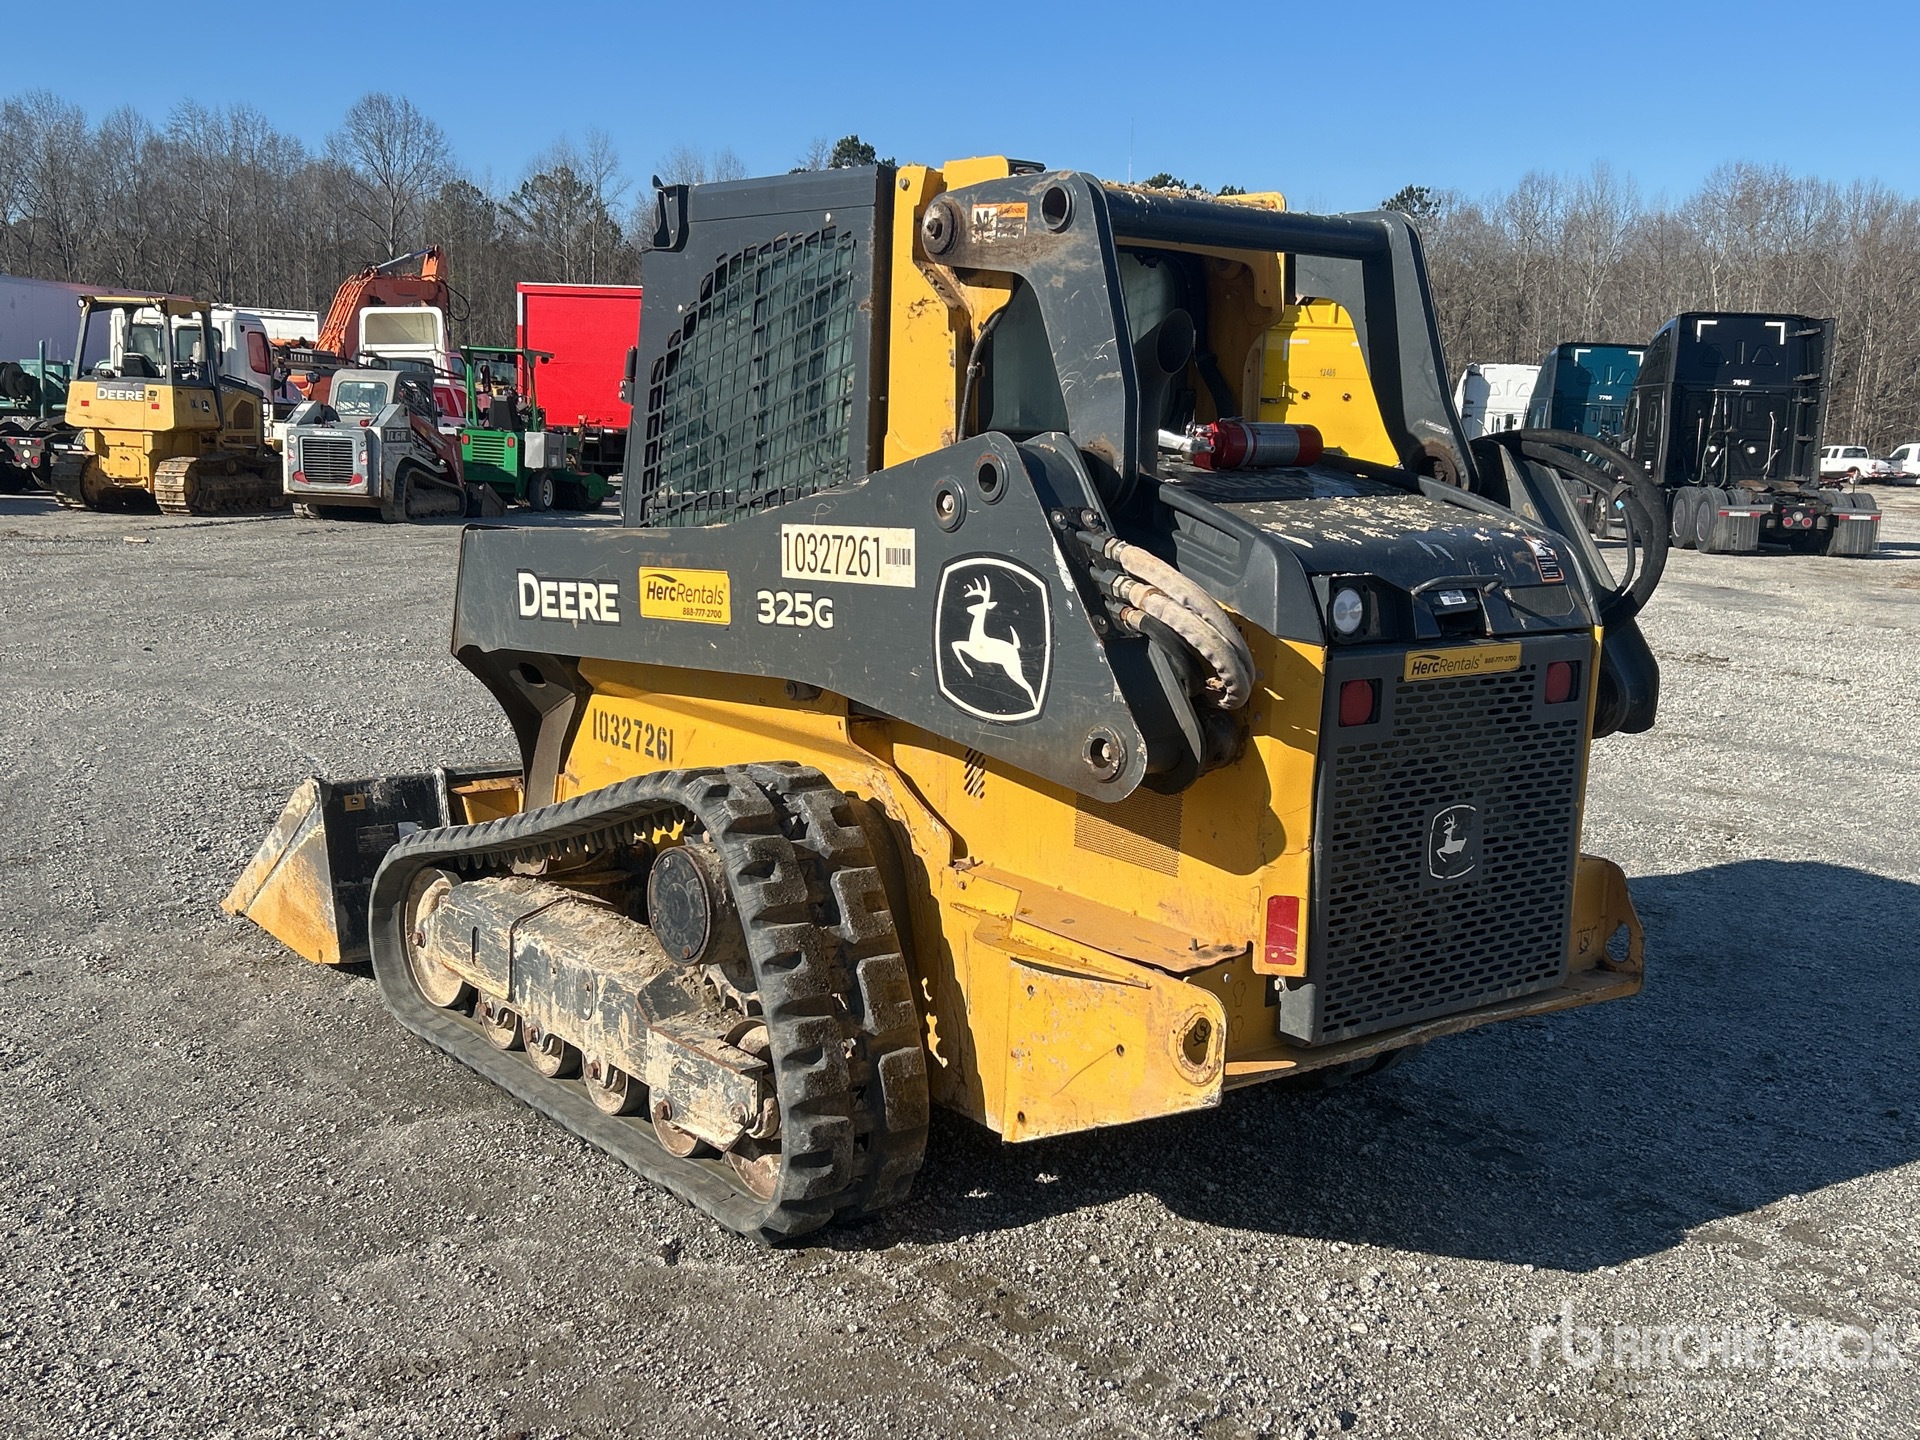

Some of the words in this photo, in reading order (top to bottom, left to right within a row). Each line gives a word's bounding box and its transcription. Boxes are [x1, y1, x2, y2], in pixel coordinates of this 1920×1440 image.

[97, 387, 145, 401] DEERE
[783, 532, 880, 578] 10327261
[518, 572, 620, 623] DEERE
[646, 580, 724, 605] HercRentals
[682, 607, 722, 619] 888-777-2700
[757, 589, 834, 629] 325G
[1411, 655, 1480, 675] HercRentals
[592, 708, 674, 764] 10327261
